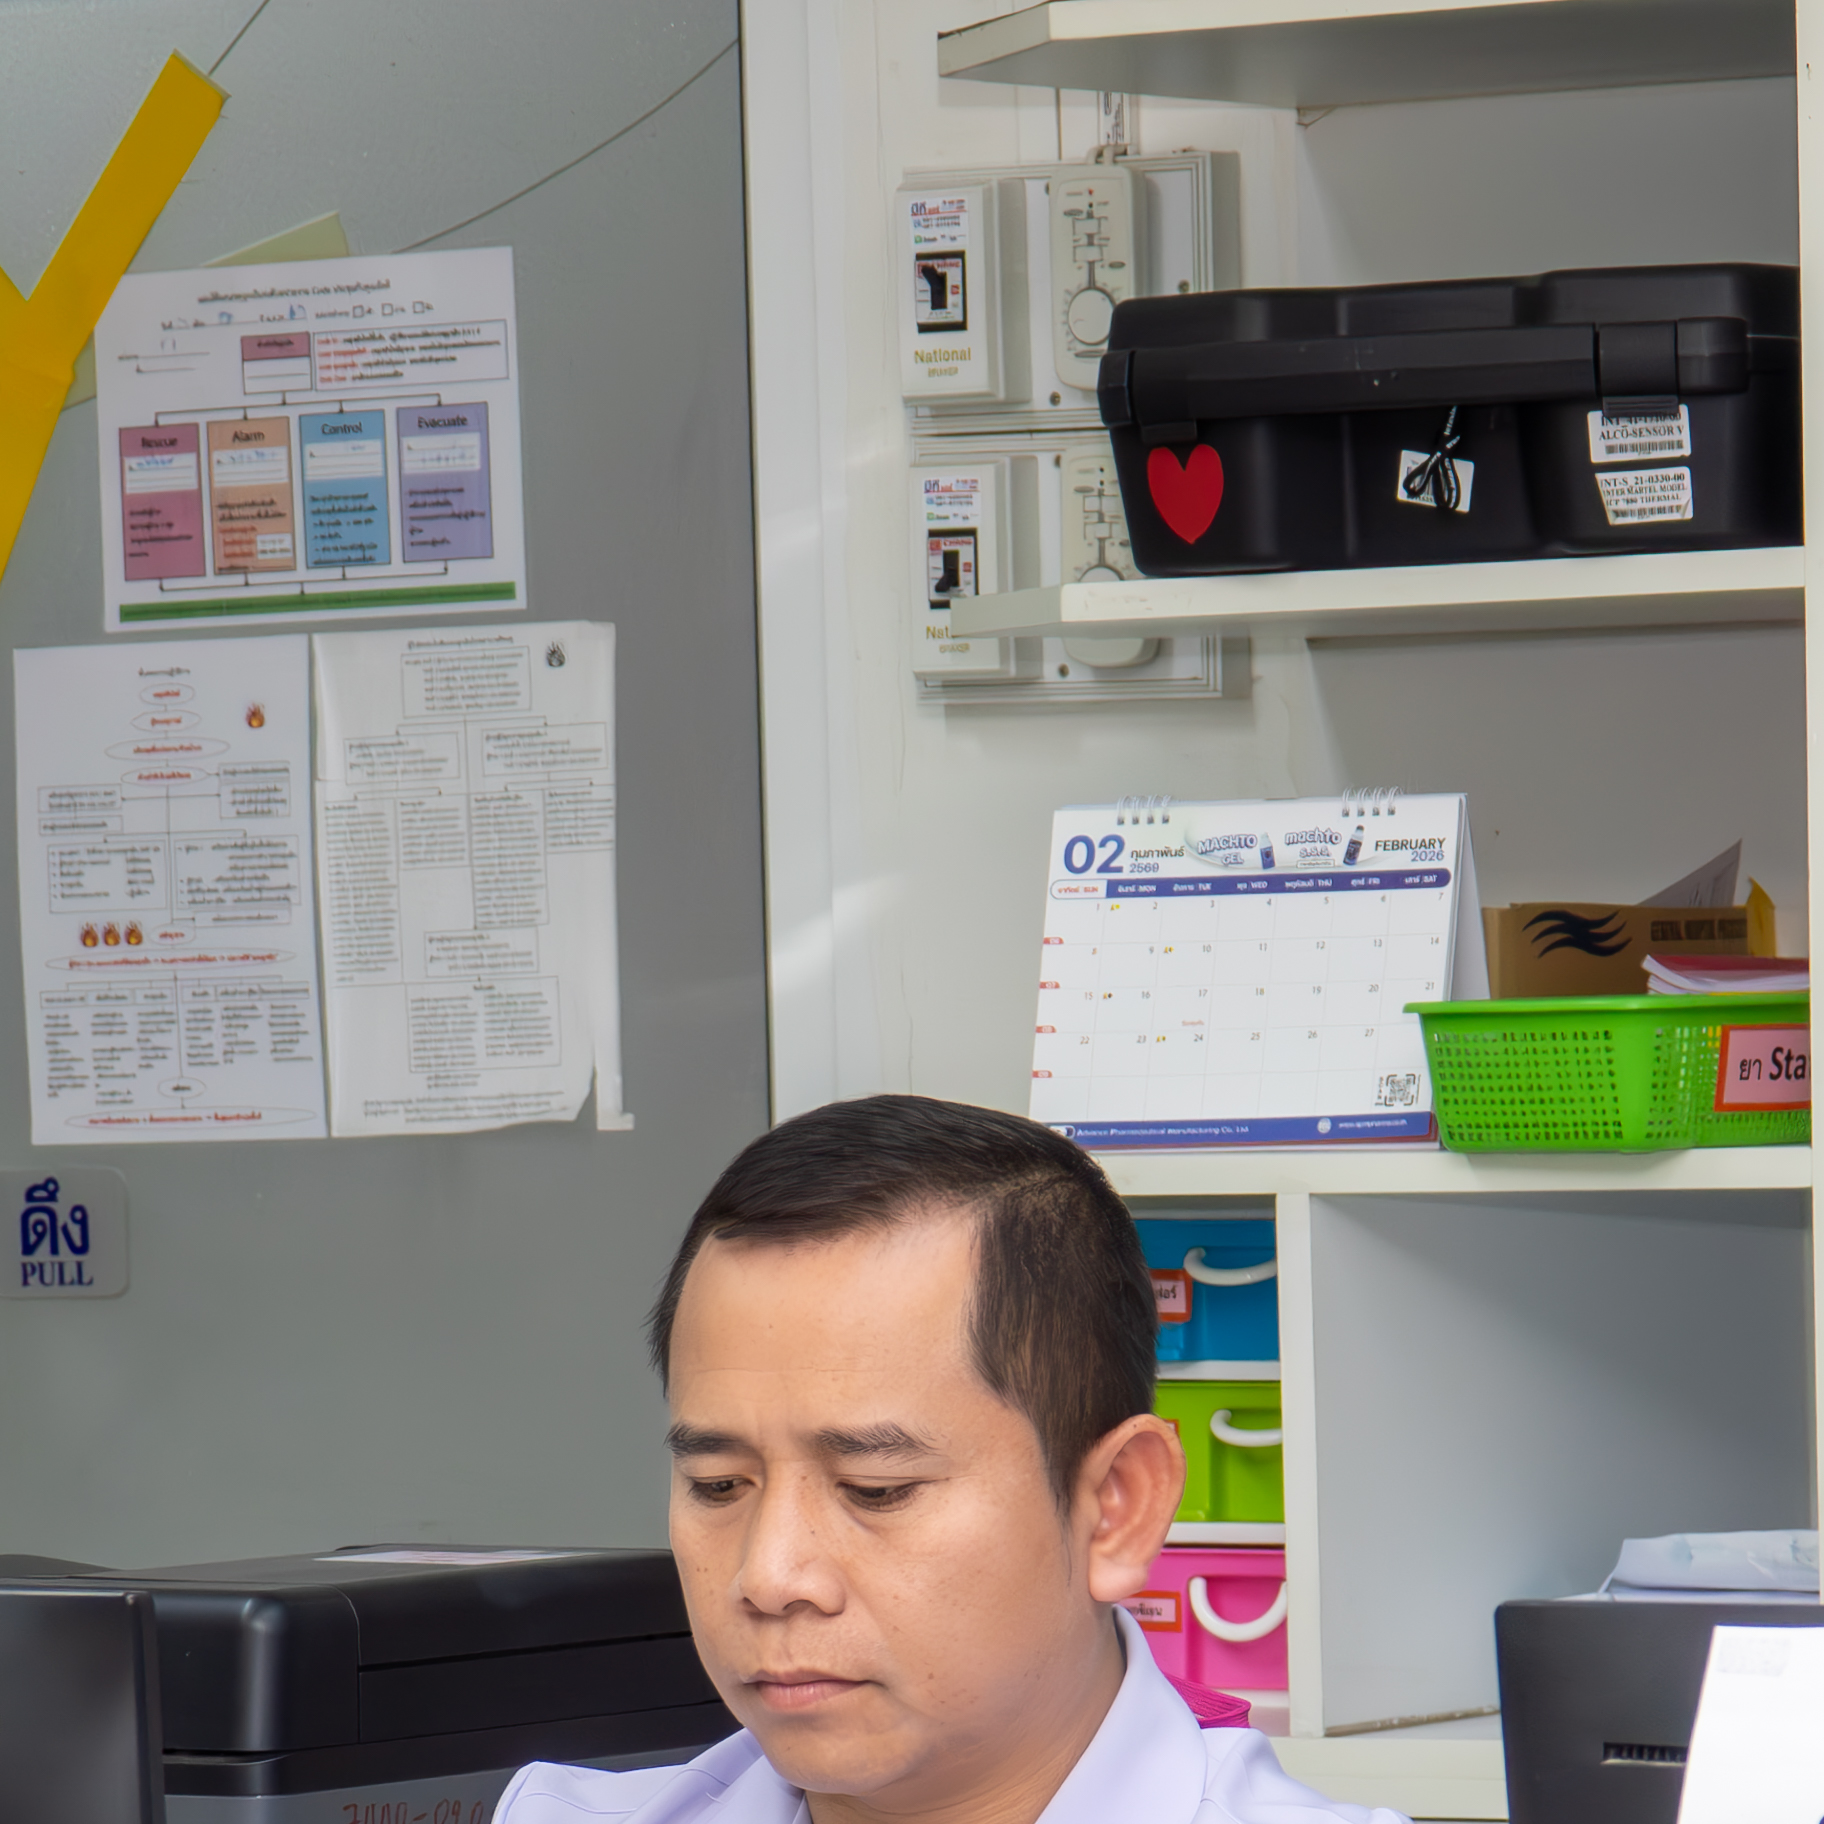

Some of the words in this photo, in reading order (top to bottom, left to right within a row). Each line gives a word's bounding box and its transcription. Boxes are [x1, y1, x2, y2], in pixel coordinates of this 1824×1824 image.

[914, 347, 972, 365] National
[321, 419, 364, 437] Control
[416, 412, 468, 430] Evacuate
[231, 427, 265, 444] Alarm
[1598, 425, 1673, 441] ALCO-SENSOR
[1196, 833, 1258, 855] MACHTO
[1284, 825, 1342, 846] machto
[1375, 837, 1447, 852] FEBRUARY
[1063, 833, 1127, 876] 02
[1130, 844, 1185, 860] กุมภาพันธ์
[1221, 852, 1245, 866] GEL
[1410, 850, 1445, 862] 2026
[1128, 861, 1160, 875] 2569
[1739, 1055, 1763, 1082] ยา
[1769, 1045, 1810, 1082] Sta
[19, 1175, 90, 1257] ดึง
[20, 1261, 94, 1287] PULL
